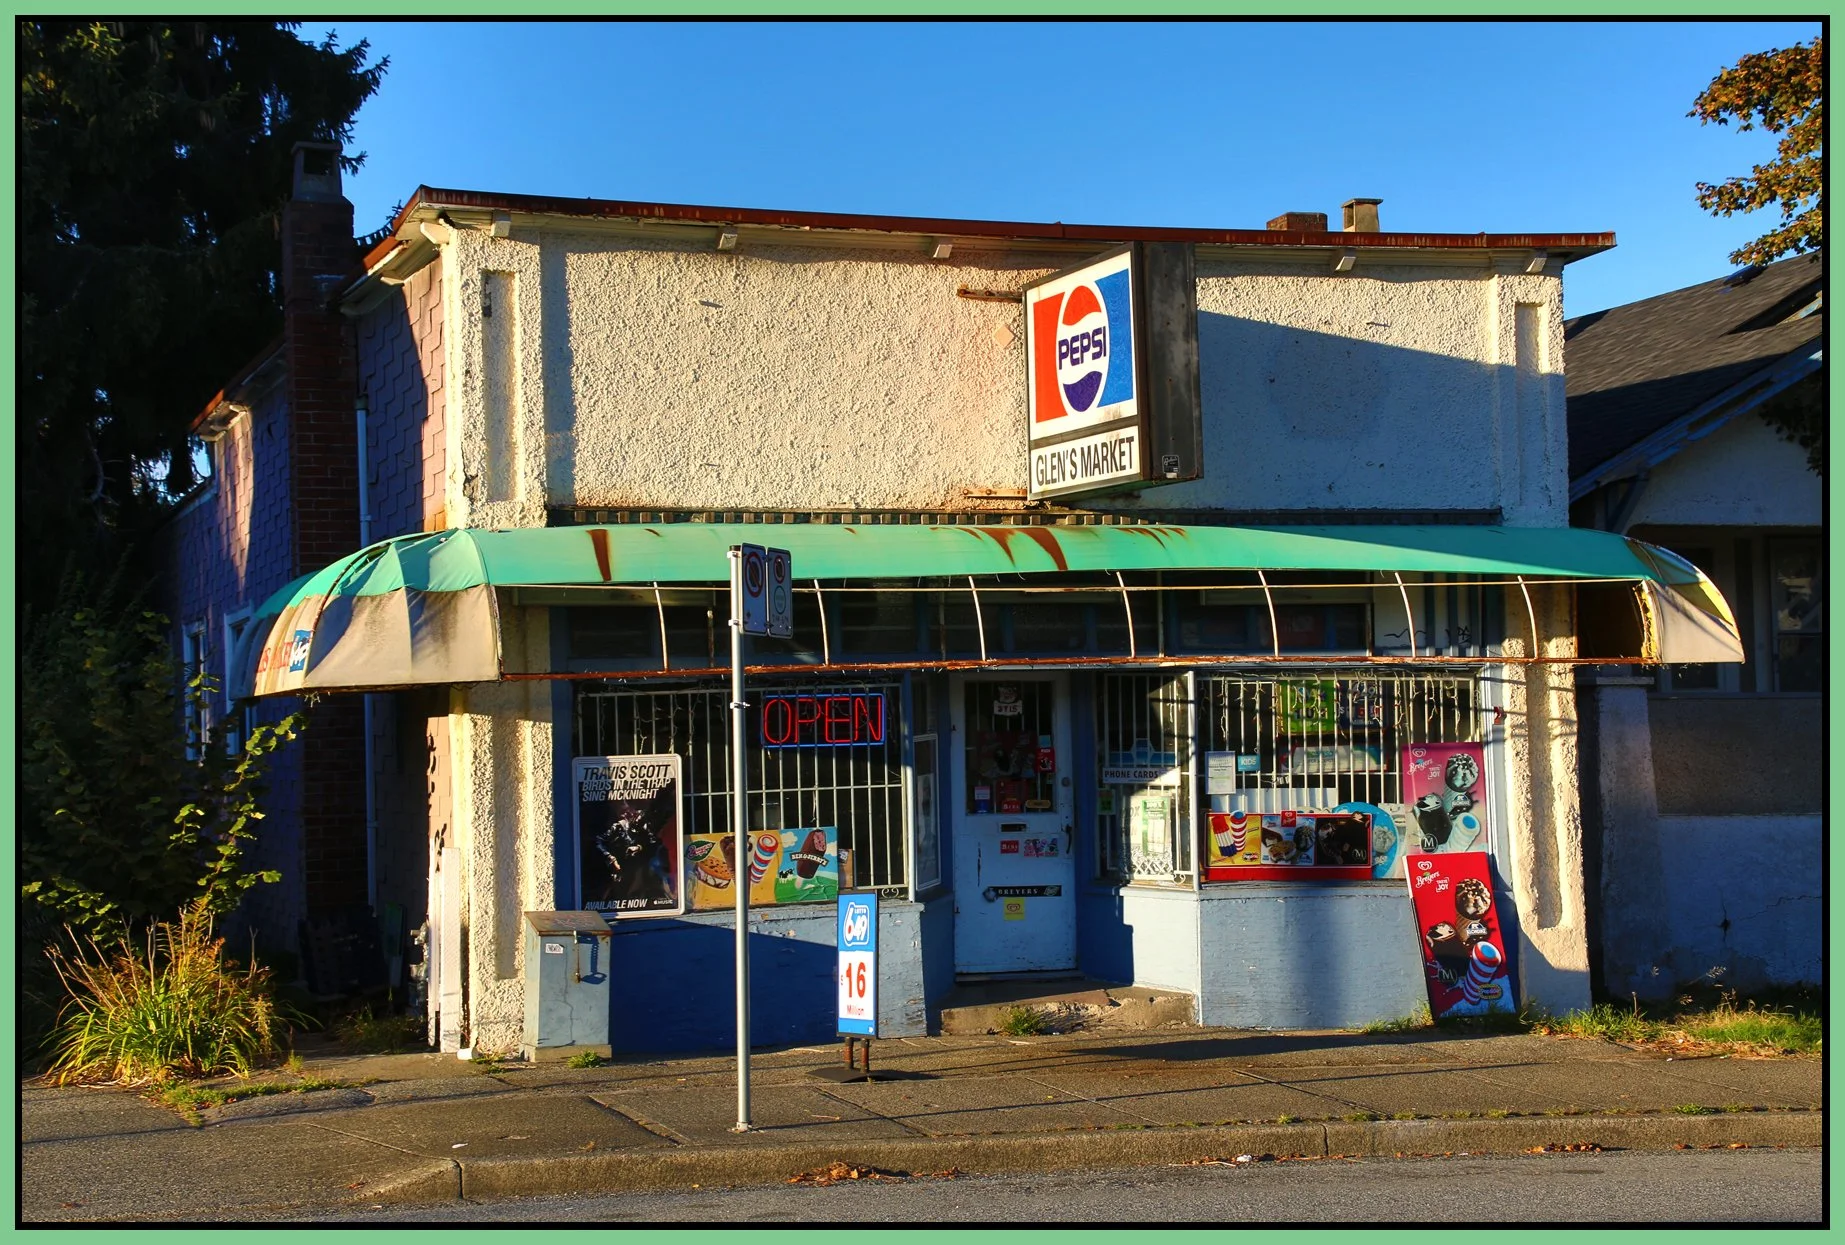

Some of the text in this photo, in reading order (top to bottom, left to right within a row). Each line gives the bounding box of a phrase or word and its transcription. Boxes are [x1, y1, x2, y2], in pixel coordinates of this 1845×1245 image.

[1058, 326, 1107, 370] PEPSI
[1036, 436, 1135, 487] GLEN'S MARKET
[764, 697, 882, 744] OPEN
[584, 764, 671, 781] TRAVIS SCOTT
[1104, 770, 1159, 779] PHONE CARDS
[582, 778, 671, 792] BIRDS IN THE TRAP
[582, 789, 659, 802] SING MCKNIGHT
[1424, 837, 1434, 847] M
[1416, 871, 1440, 888] Breyers
[585, 901, 626, 910] AVAILABLE
[627, 899, 648, 909] NOW
[846, 962, 866, 998] 16
